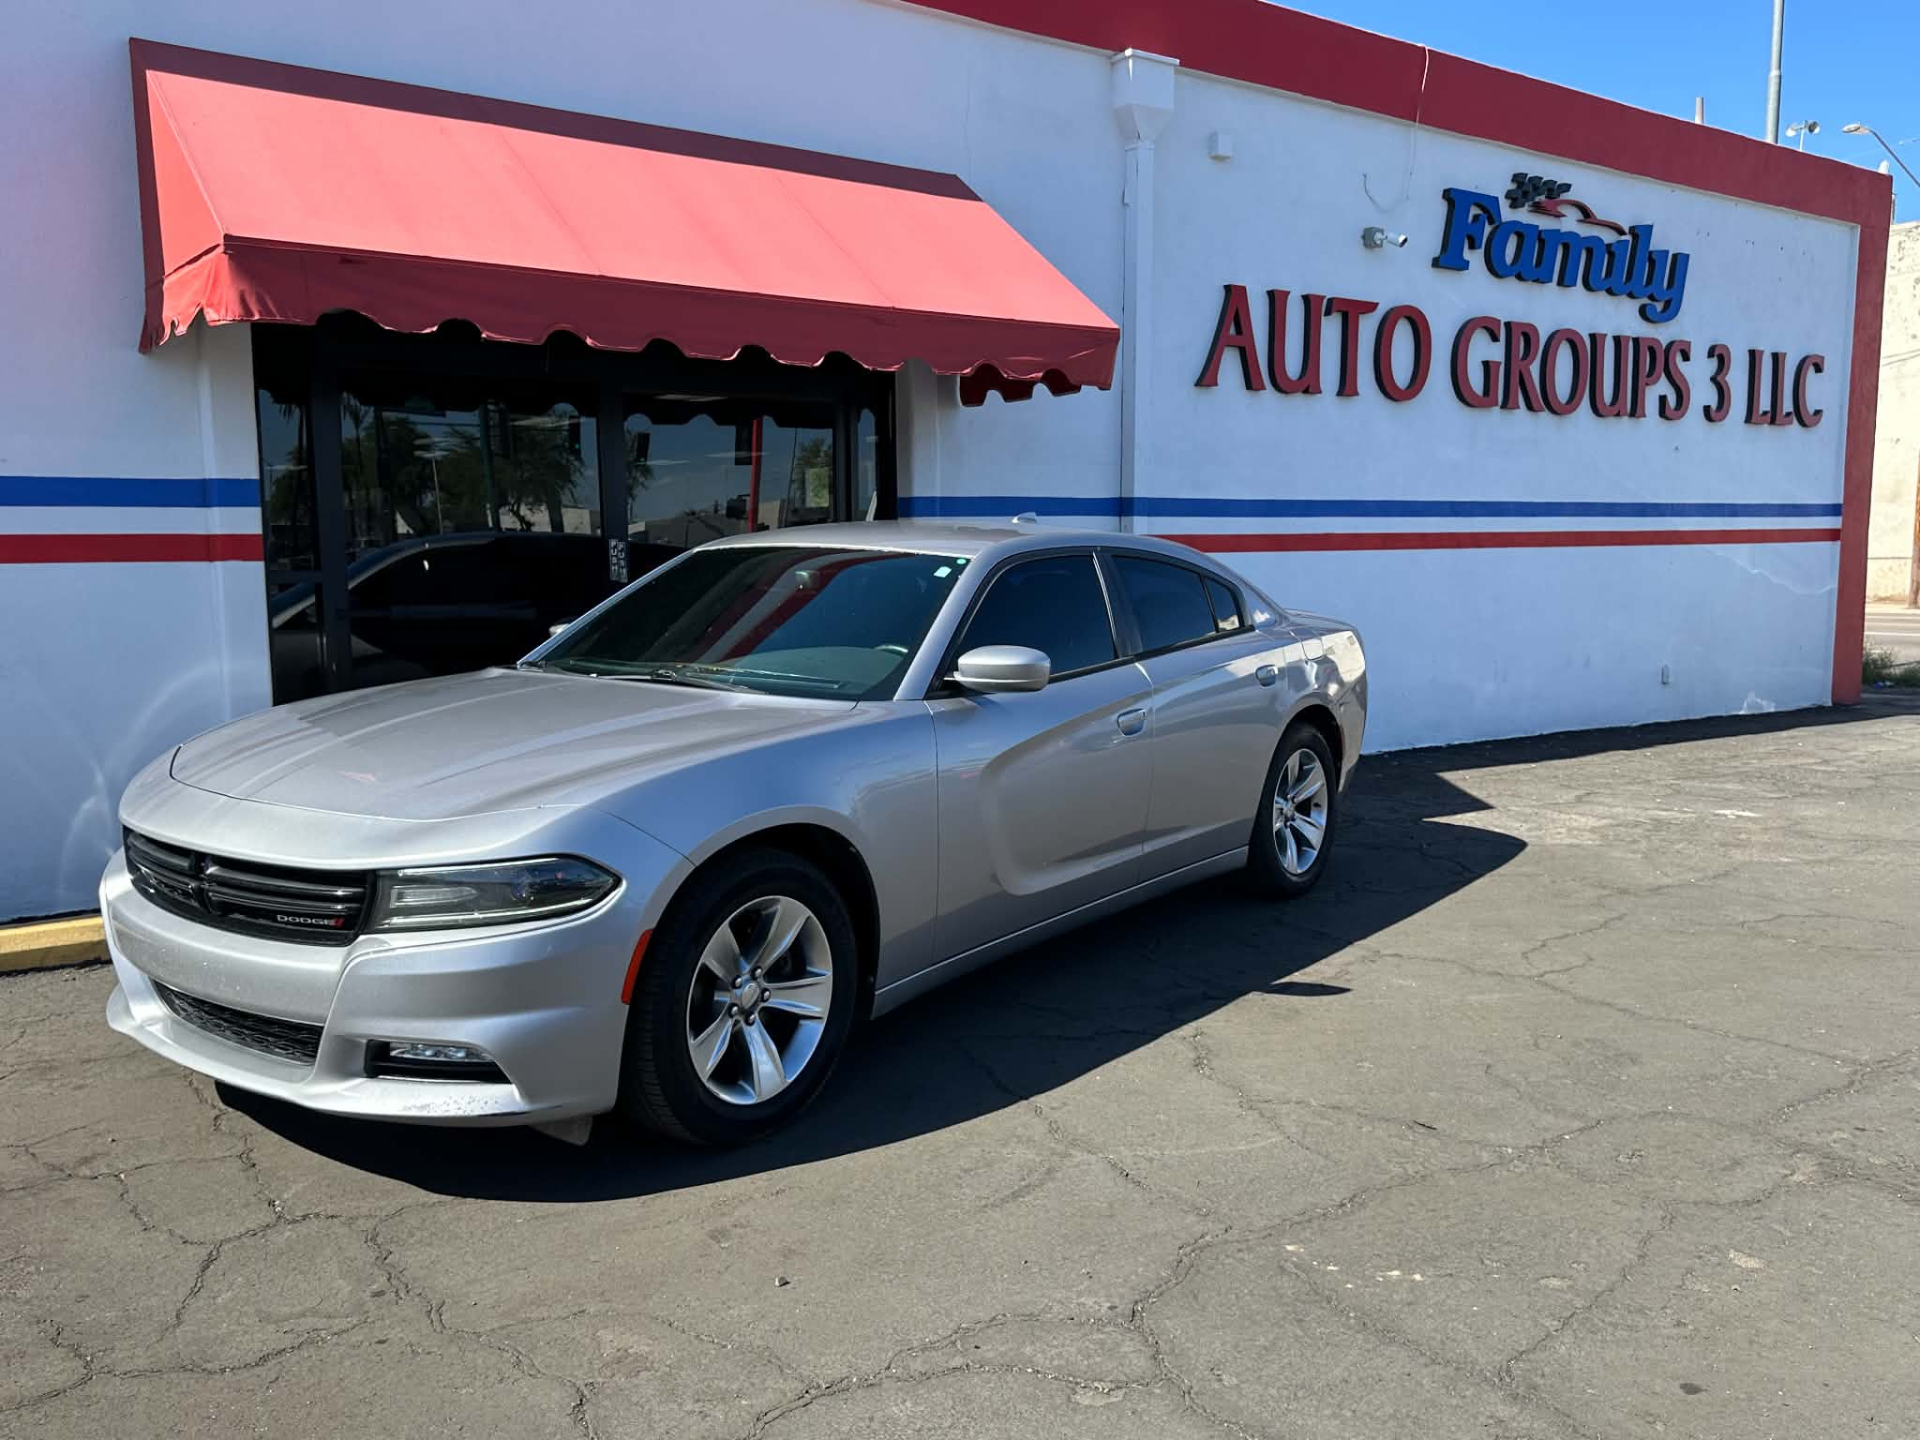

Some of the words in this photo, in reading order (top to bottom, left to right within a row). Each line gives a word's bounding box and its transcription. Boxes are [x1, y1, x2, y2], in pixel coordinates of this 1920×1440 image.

[1431, 187, 1690, 323] Family
[1194, 284, 1432, 402] AUTO
[1451, 315, 1692, 421] GROUPS
[1703, 343, 1732, 423] 3
[1744, 349, 1825, 428] LLC
[276, 914, 335, 926] DODGE
